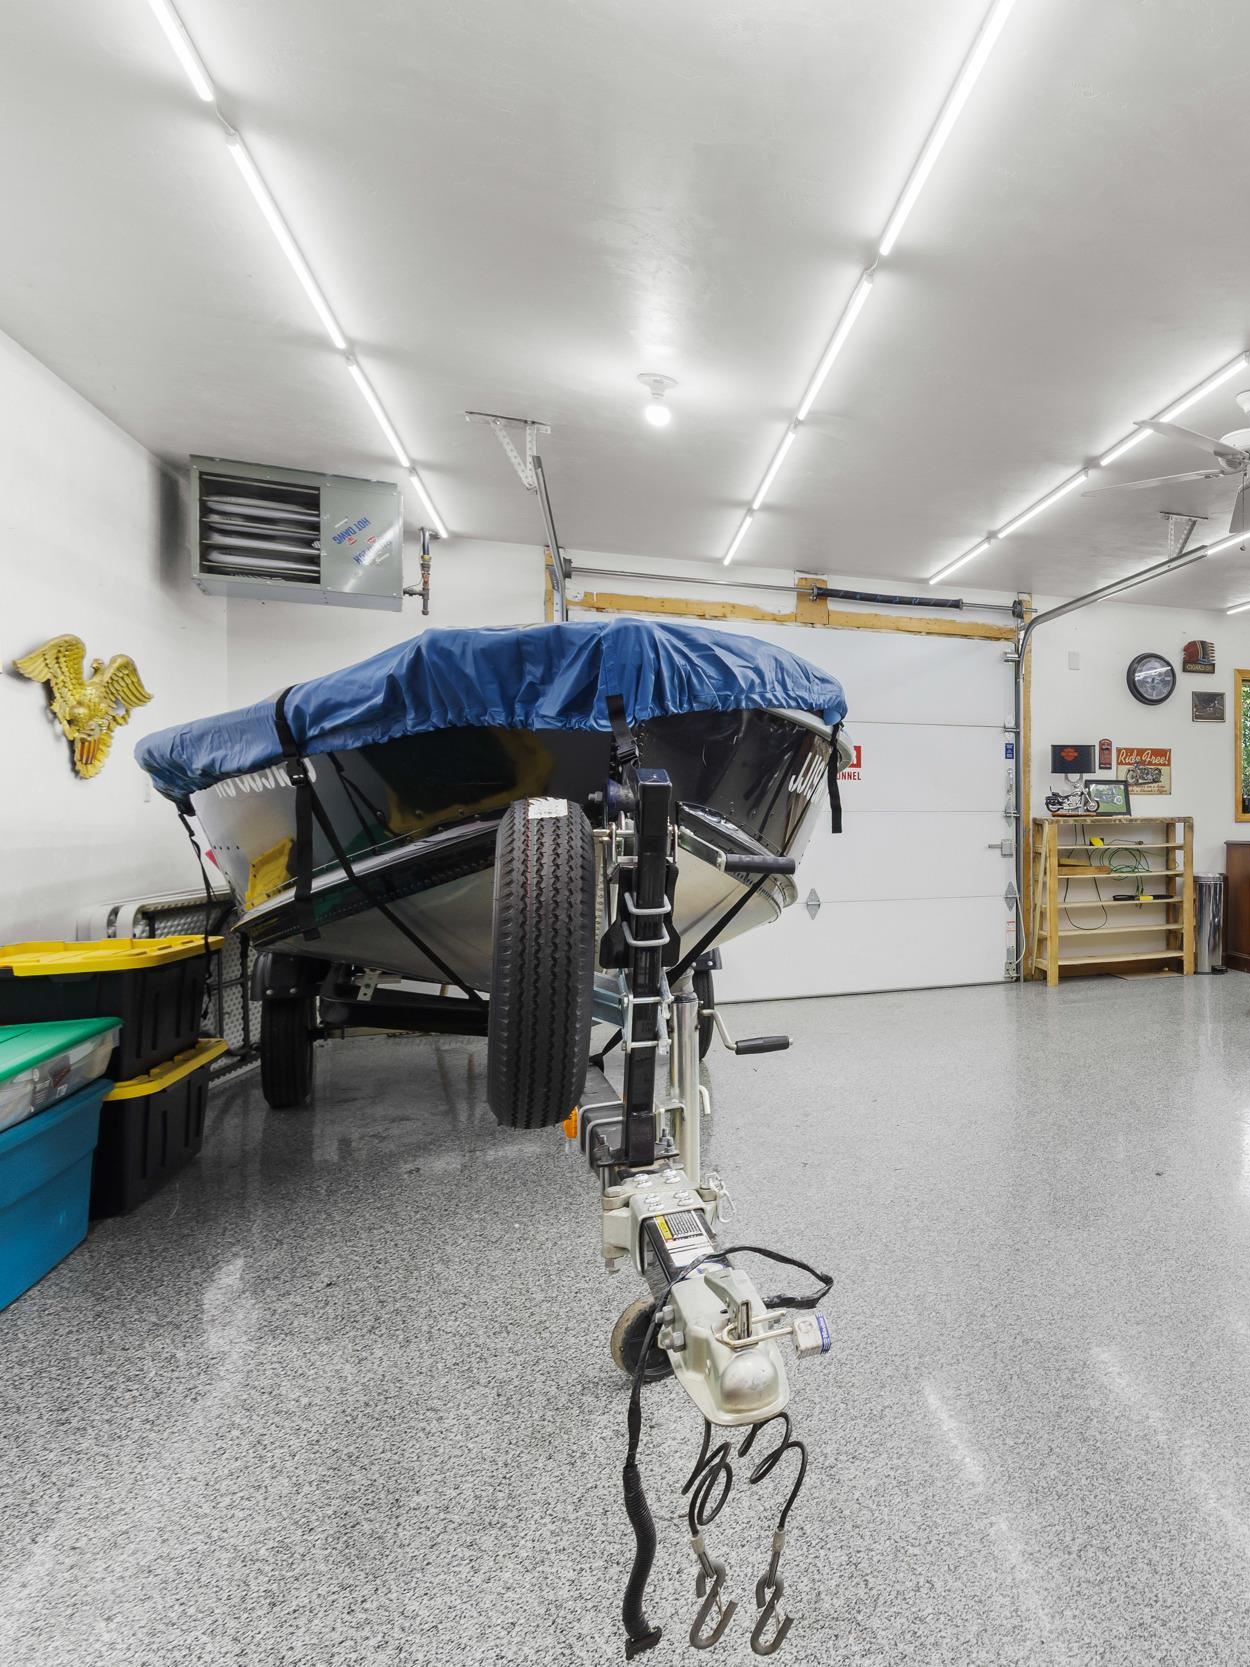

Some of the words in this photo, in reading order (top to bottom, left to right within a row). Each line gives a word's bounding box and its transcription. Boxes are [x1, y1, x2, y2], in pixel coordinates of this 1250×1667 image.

[353, 517, 371, 531] HOT
[332, 526, 356, 544] DAWG
[1118, 749, 1141, 763] Ride
[1142, 749, 1169, 764] Free!
[836, 771, 862, 780] ONNEL
